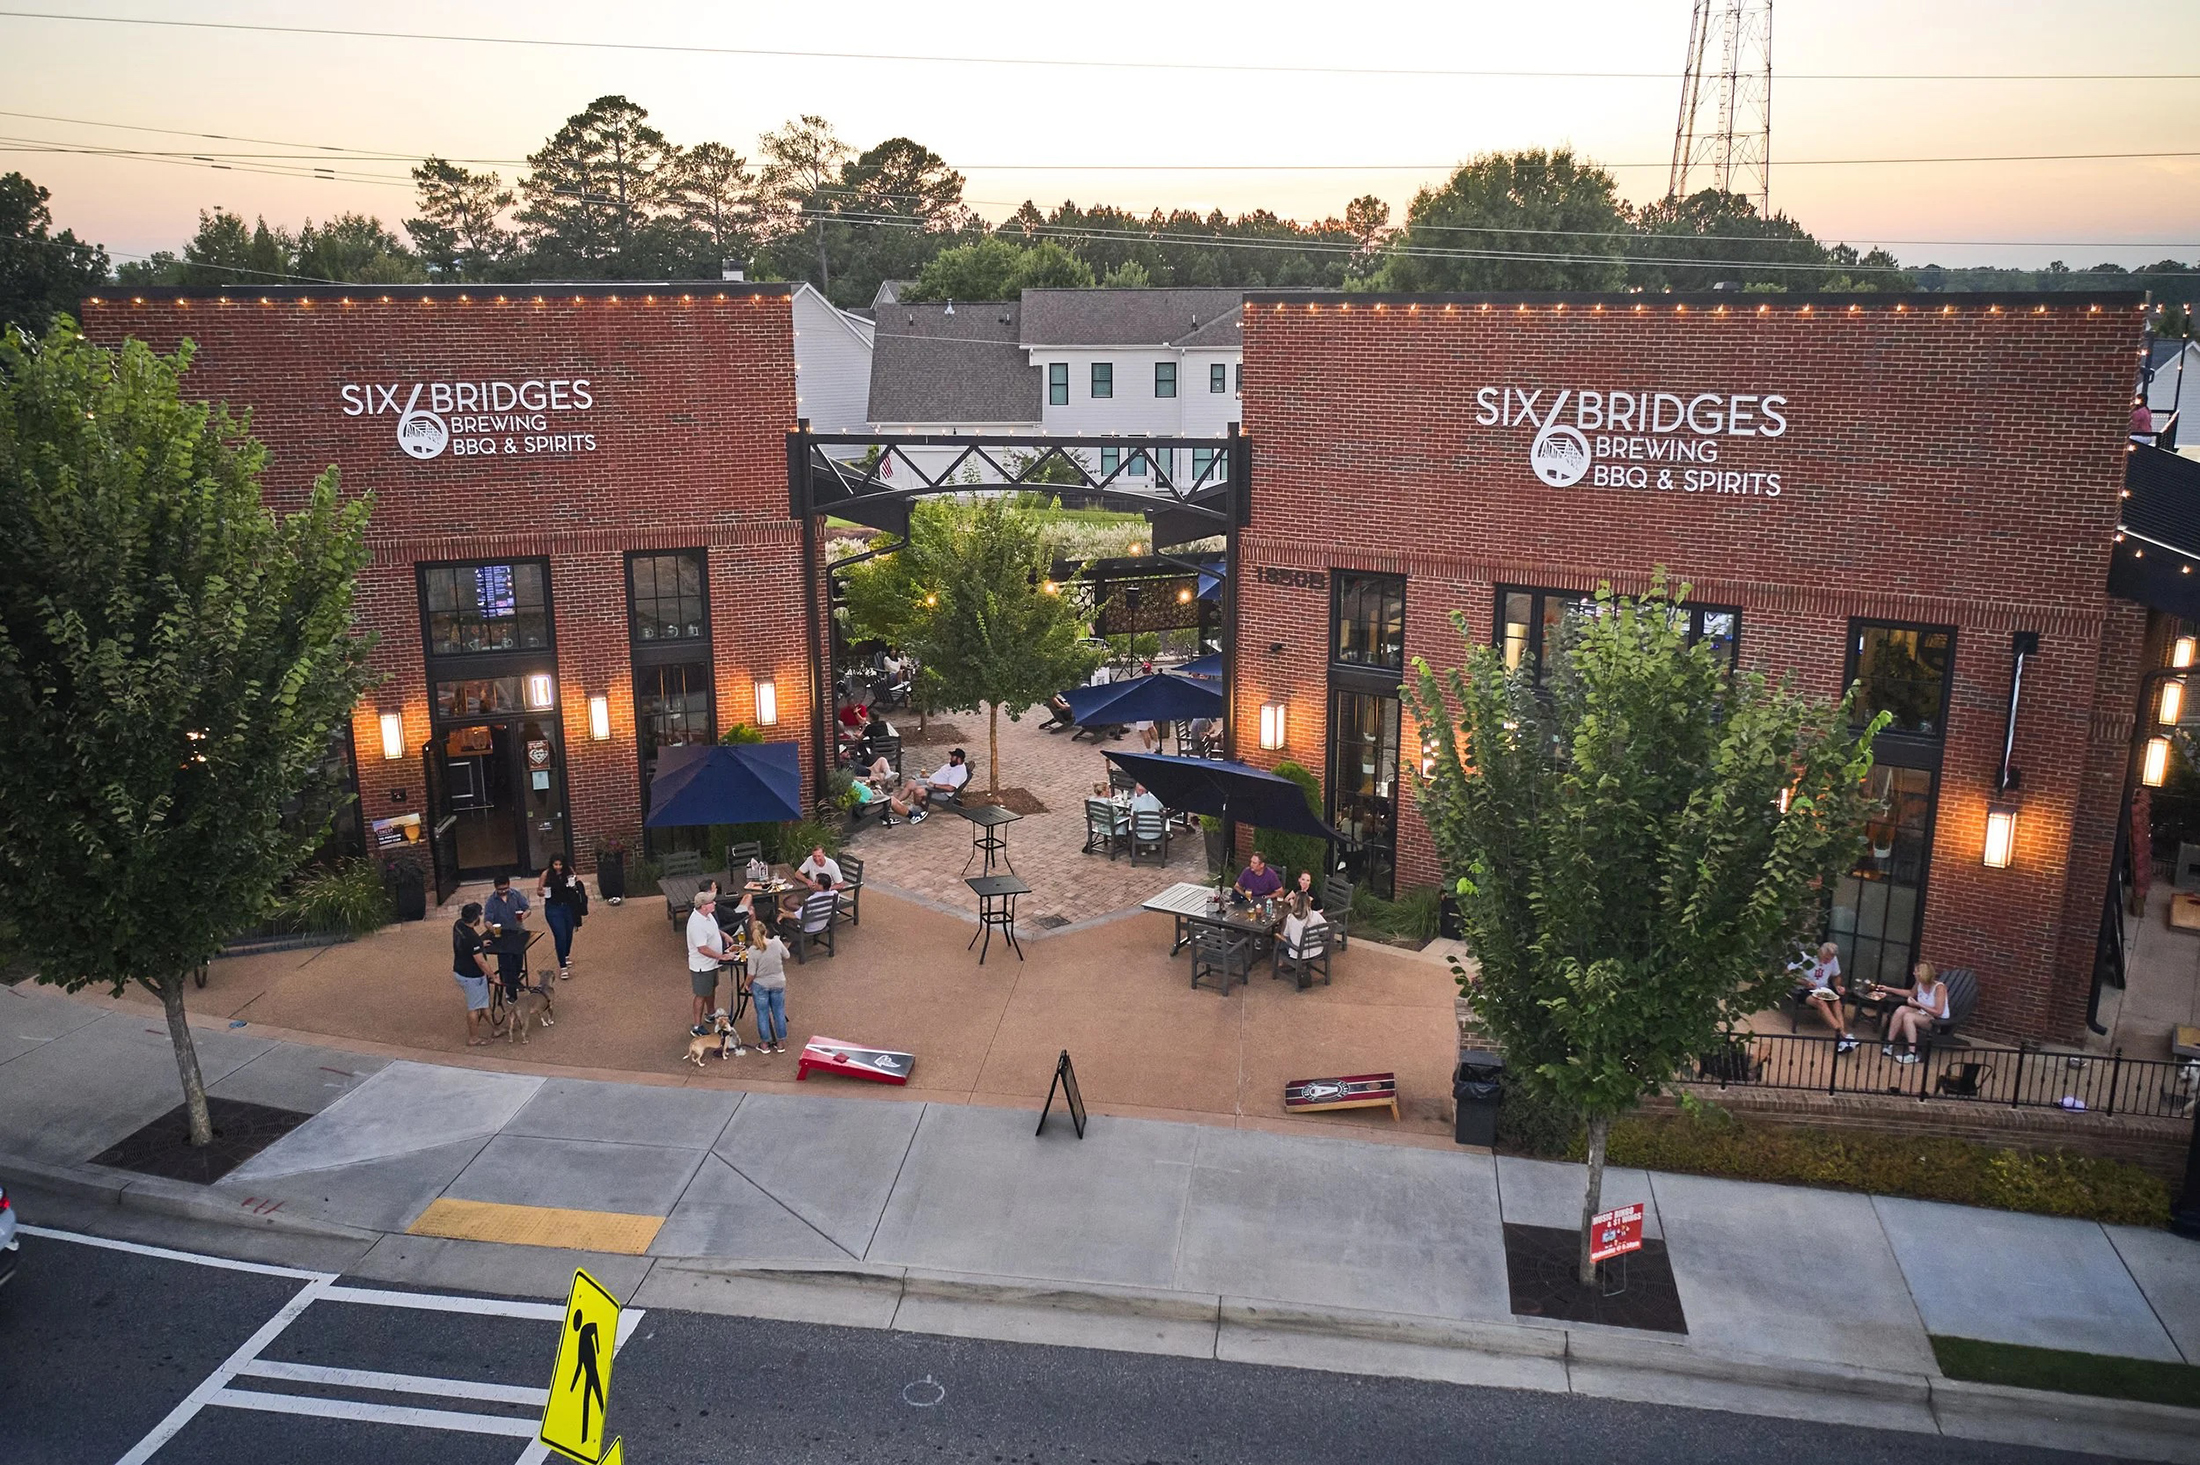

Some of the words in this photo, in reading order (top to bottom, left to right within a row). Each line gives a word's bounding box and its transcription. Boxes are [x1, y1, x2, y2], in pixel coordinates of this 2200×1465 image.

[341, 383, 402, 416] SIX
[430, 379, 593, 413] BRIDGES
[451, 414, 547, 433] BREWING
[1475, 386, 1543, 428] SIX
[1577, 390, 1788, 437] BRIDGES
[453, 437, 498, 456] BBQ
[503, 436, 518, 453] &
[524, 434, 597, 453] SPIRITS
[1595, 436, 1718, 463] BREWING
[1593, 465, 1648, 489] BBQ
[1656, 469, 1675, 491] &
[1683, 470, 1782, 497] SPIRITS
[1592, 1212, 1613, 1225] MUSIC
